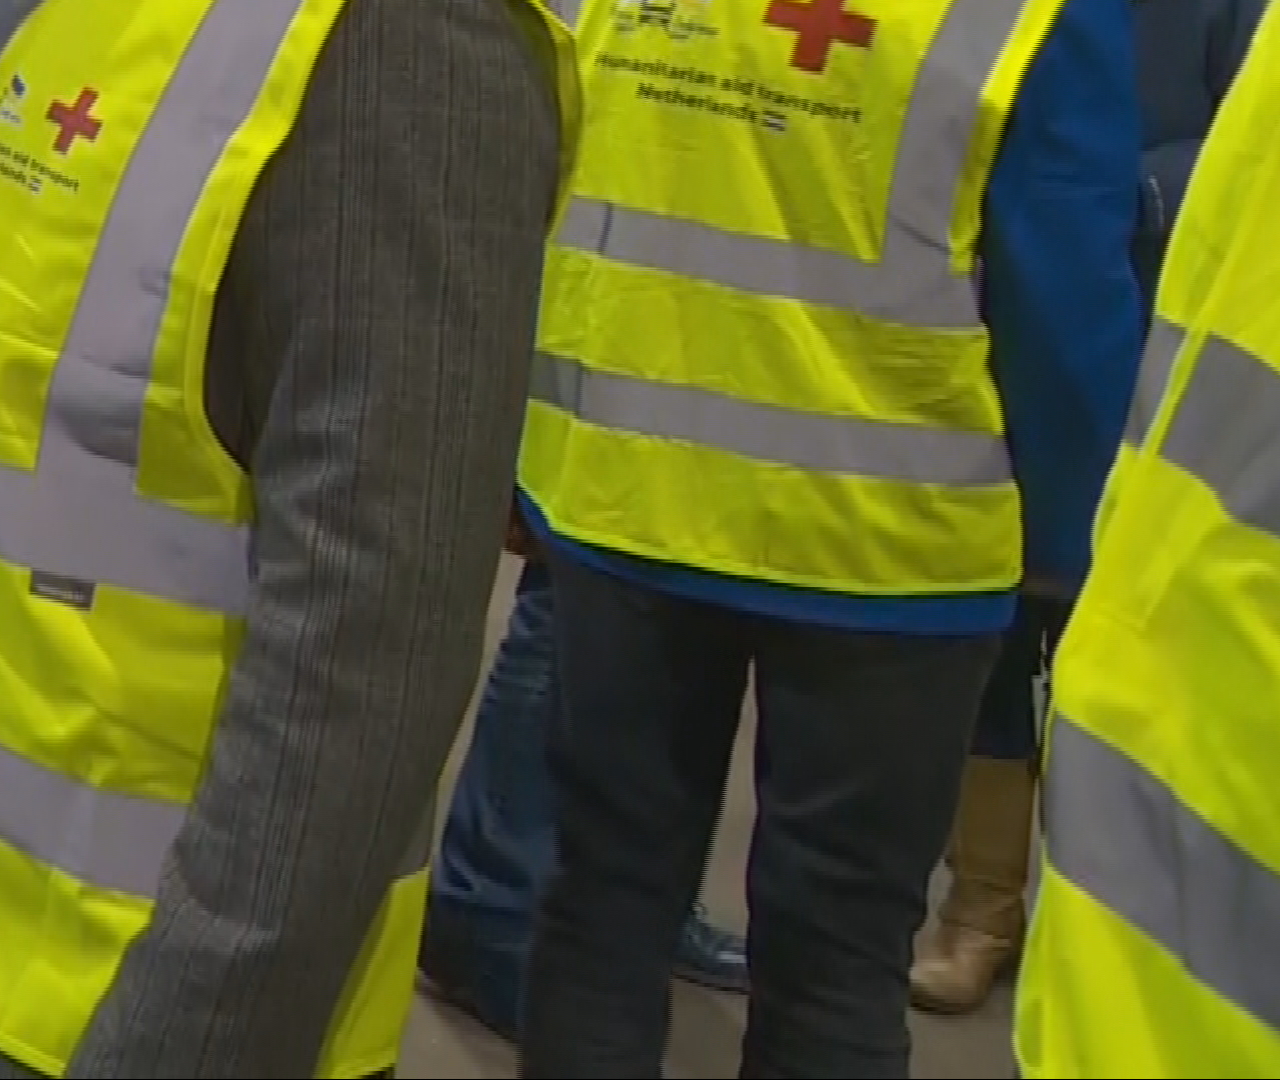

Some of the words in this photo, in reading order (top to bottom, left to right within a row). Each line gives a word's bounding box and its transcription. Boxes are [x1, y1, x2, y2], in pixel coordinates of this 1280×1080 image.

[594, 51, 716, 87] Humanitarian
[757, 84, 862, 124] transport
[636, 82, 757, 124] Netherlands
